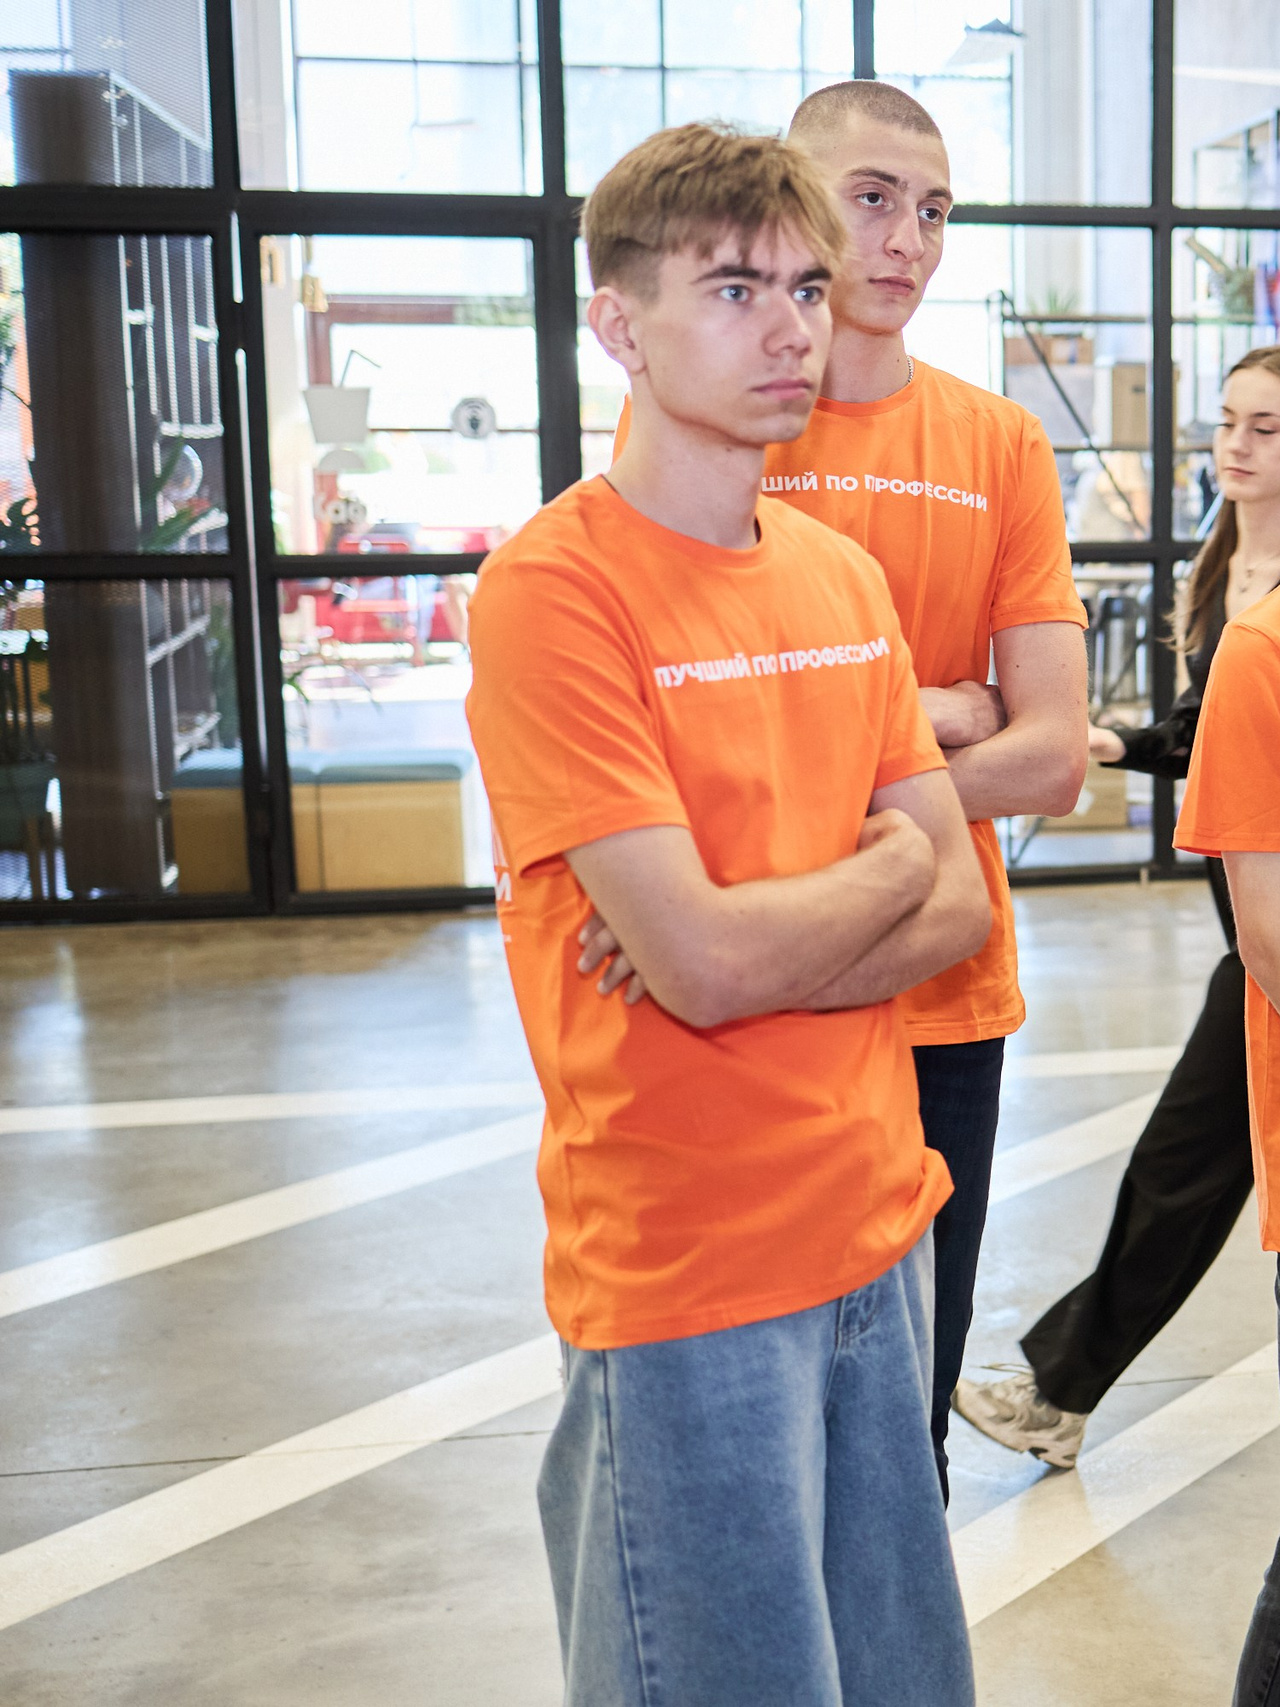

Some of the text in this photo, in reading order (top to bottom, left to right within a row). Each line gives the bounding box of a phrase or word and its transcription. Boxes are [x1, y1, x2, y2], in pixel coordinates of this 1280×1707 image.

[761, 470, 988, 512] ШИЙ ПО ПРОФЕССИИ
[653, 636, 891, 688] ЛУЧШИЙ ПО ПРОФЕССИИ
